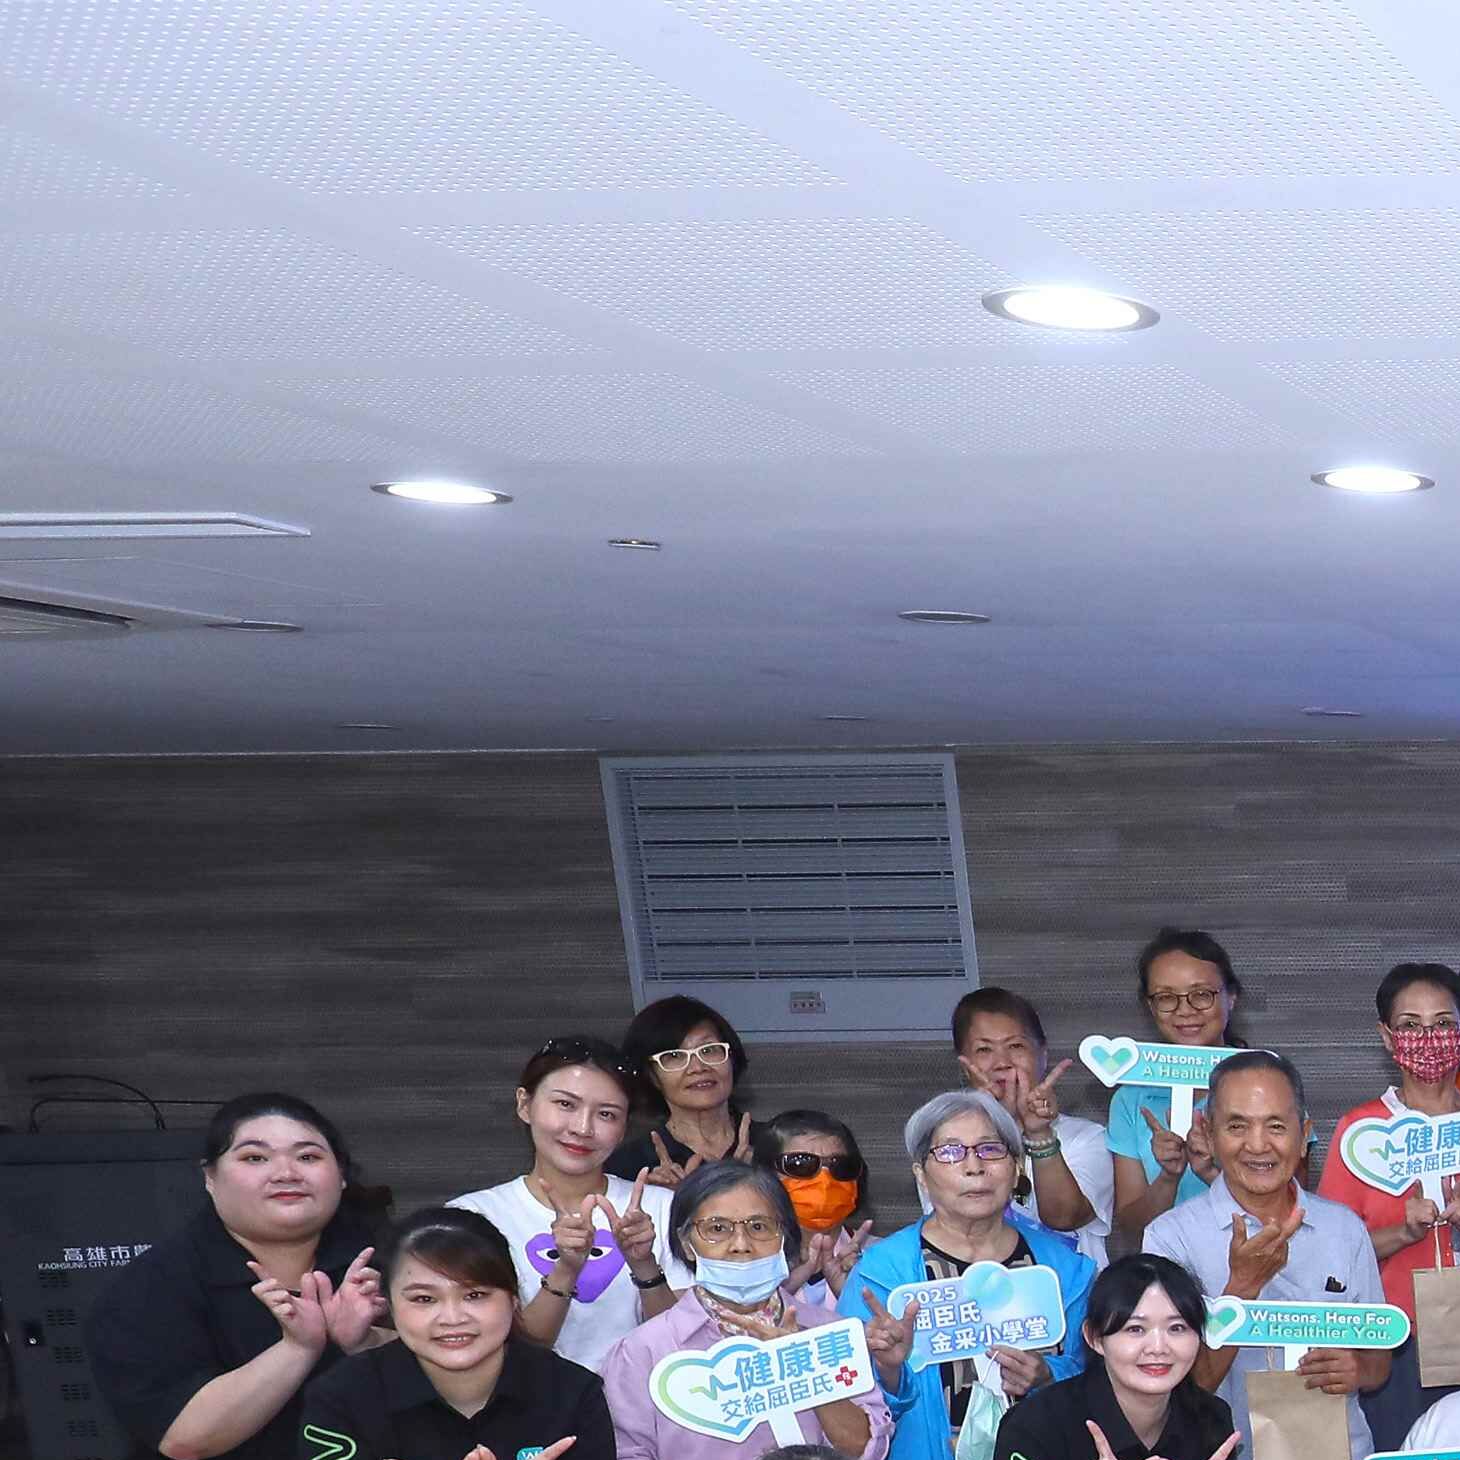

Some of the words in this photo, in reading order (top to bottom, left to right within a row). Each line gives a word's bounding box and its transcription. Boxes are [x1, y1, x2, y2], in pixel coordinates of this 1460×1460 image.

[1142, 1050, 1206, 1065] Watsons.
[1142, 1067, 1153, 1077] A
[88, 1260, 108, 1269] CITY
[902, 1286, 957, 1304] 2025
[1250, 1309, 1321, 1324] Watsons.
[1325, 1311, 1361, 1325] Here
[1365, 1312, 1392, 1326] For
[930, 1316, 1050, 1355] 金采小學堂
[1251, 1326, 1263, 1337] A
[1268, 1325, 1349, 1340] Healthier
[1352, 1327, 1392, 1341] You.
[734, 1328, 855, 1393] 健康事
[720, 1372, 834, 1423] 交給屈臣氏
